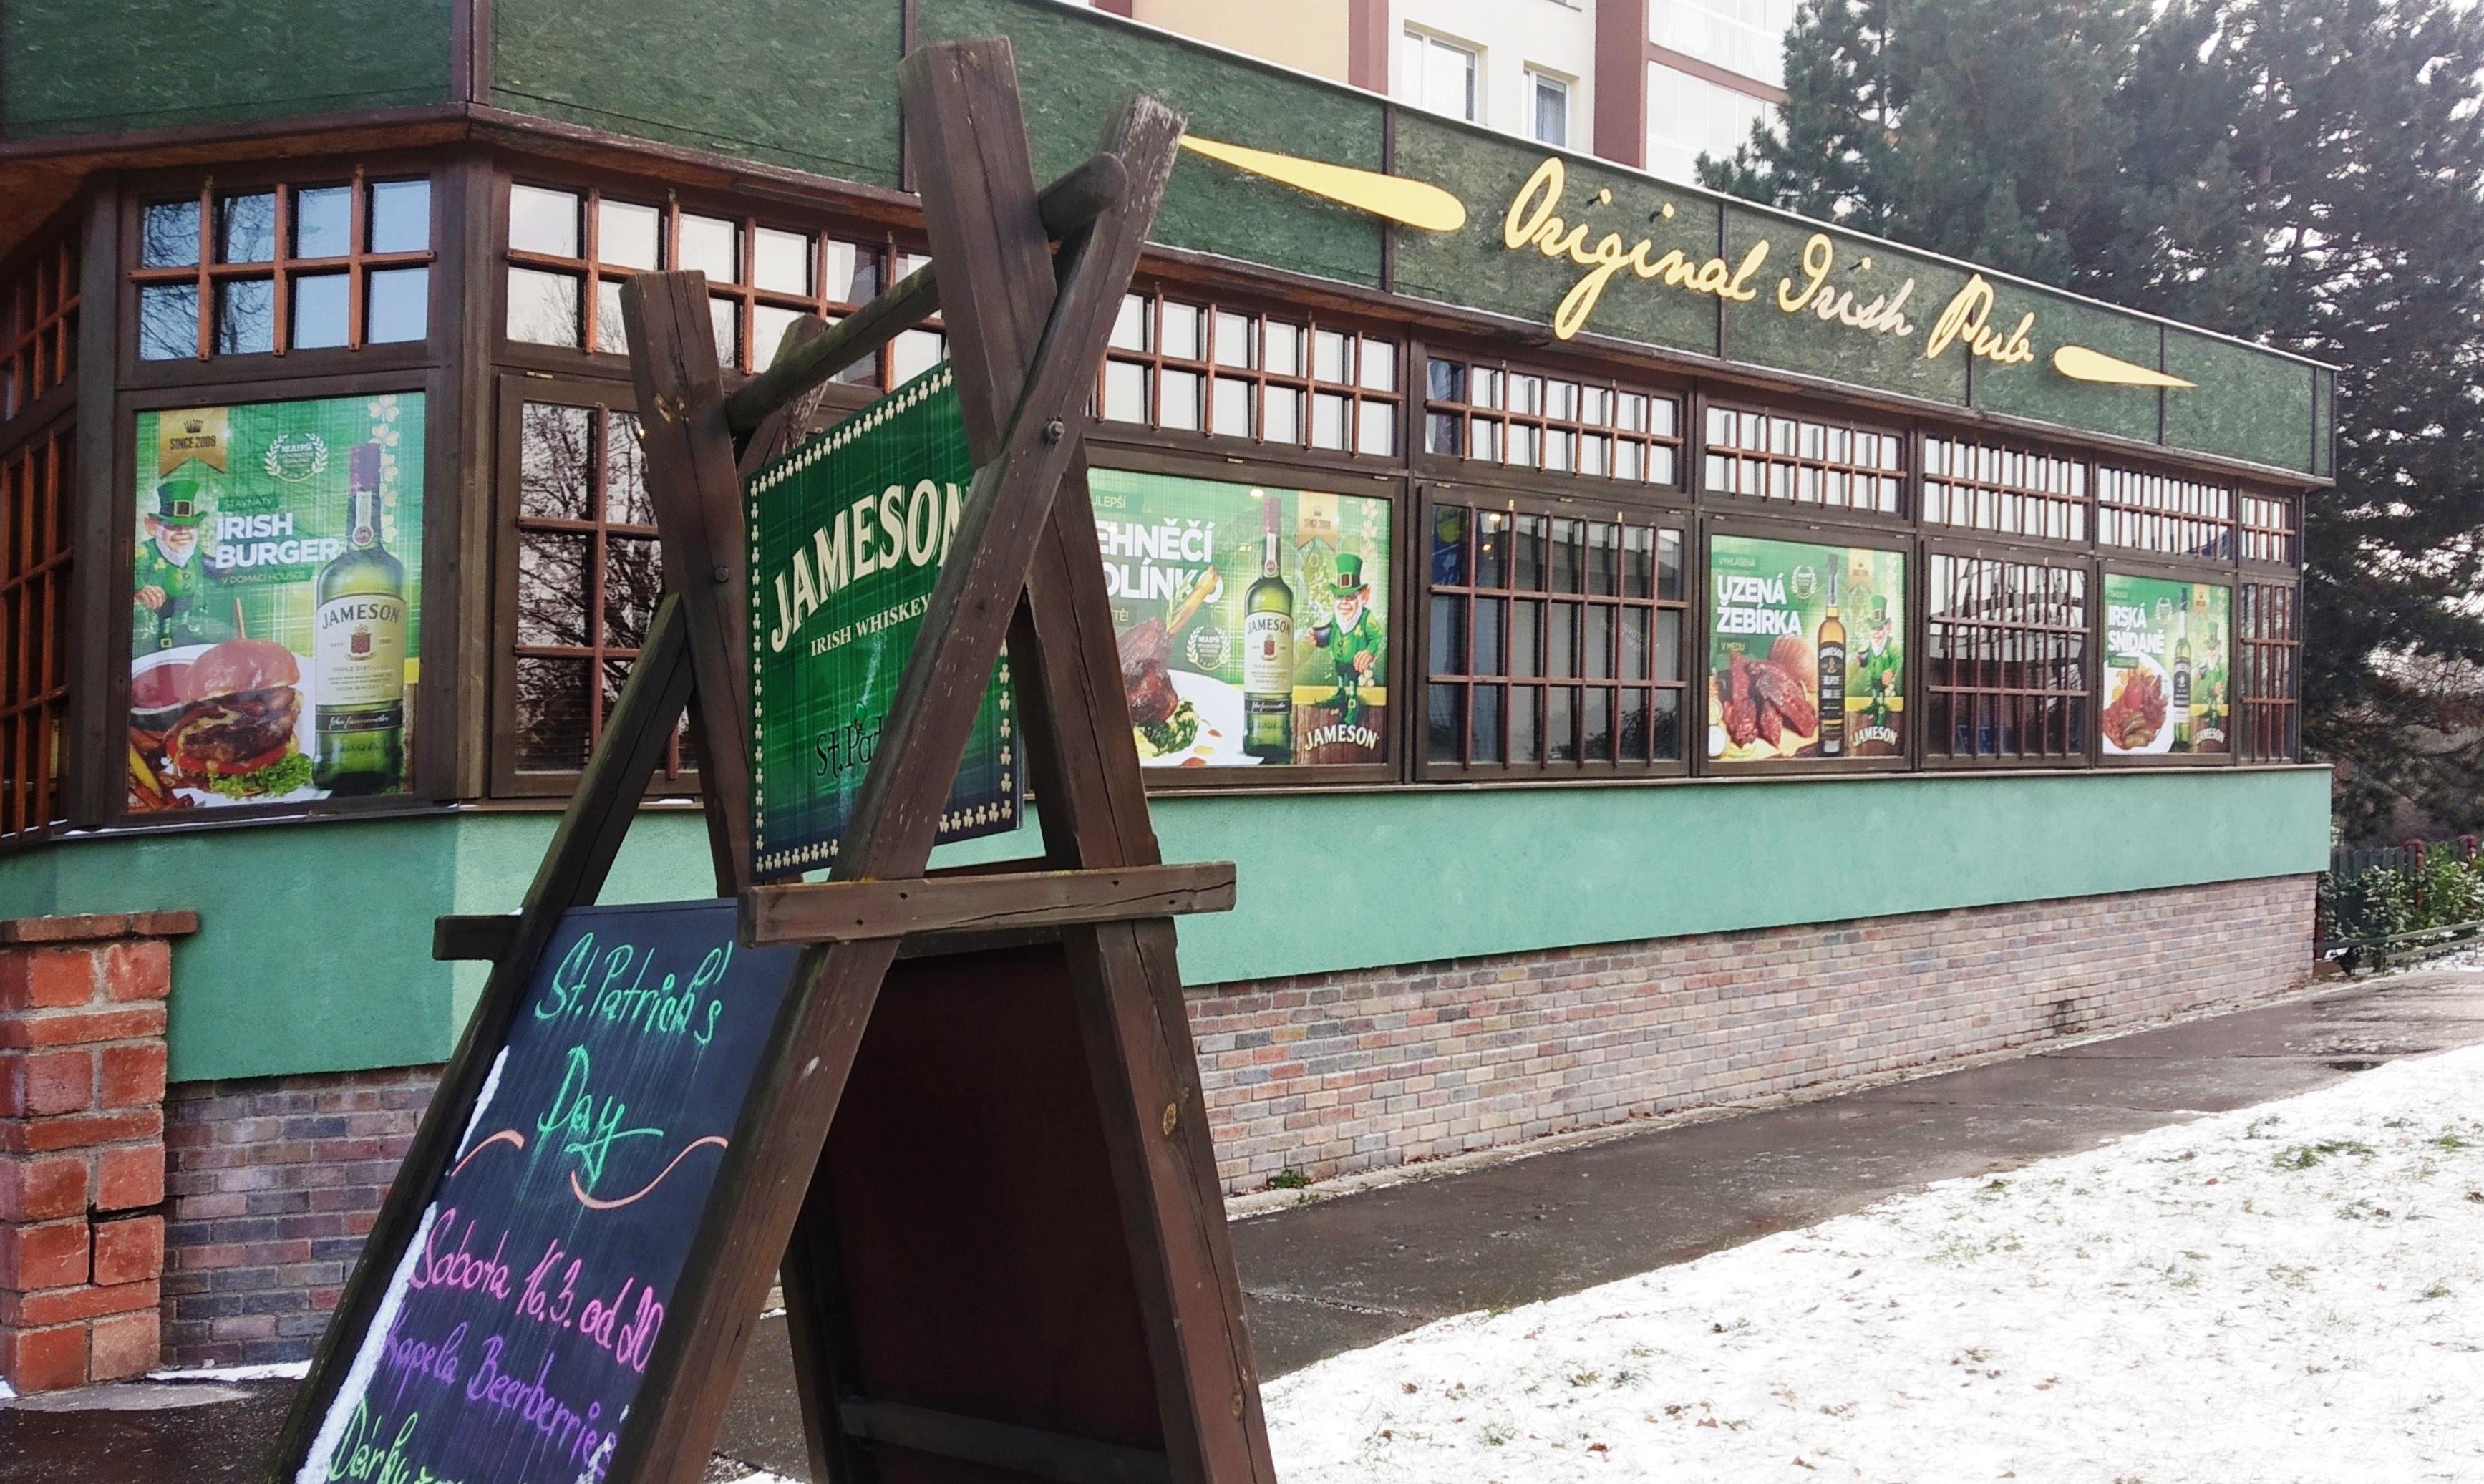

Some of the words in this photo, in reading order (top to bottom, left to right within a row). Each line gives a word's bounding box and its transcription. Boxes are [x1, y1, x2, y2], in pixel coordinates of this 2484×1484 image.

[1504, 156, 1770, 341] Original
[1777, 233, 1914, 336] Irish
[1927, 274, 2035, 364] Pub
[1092, 495, 1126, 508] JLEPŠÍ
[216, 513, 293, 540] IRISH
[1095, 518, 1216, 563] EHNĚČÍ
[215, 538, 339, 569] BURGER
[1102, 556, 1223, 603] OLÍNKO
[1717, 573, 1787, 605] UZENÁ
[322, 603, 401, 629] JAMESON
[811, 625, 852, 657] IRISH
[855, 593, 932, 638] WHISKEY
[1247, 618, 1291, 636] JAMESON
[1716, 600, 1803, 636] ŽEBÍRKA
[1304, 724, 1377, 751] JAMESON
[1853, 726, 1897, 747] JAMESON
[537, 1044, 664, 1183] Day
[409, 1208, 511, 1300] Sobota
[580, 1277, 634, 1349] od
